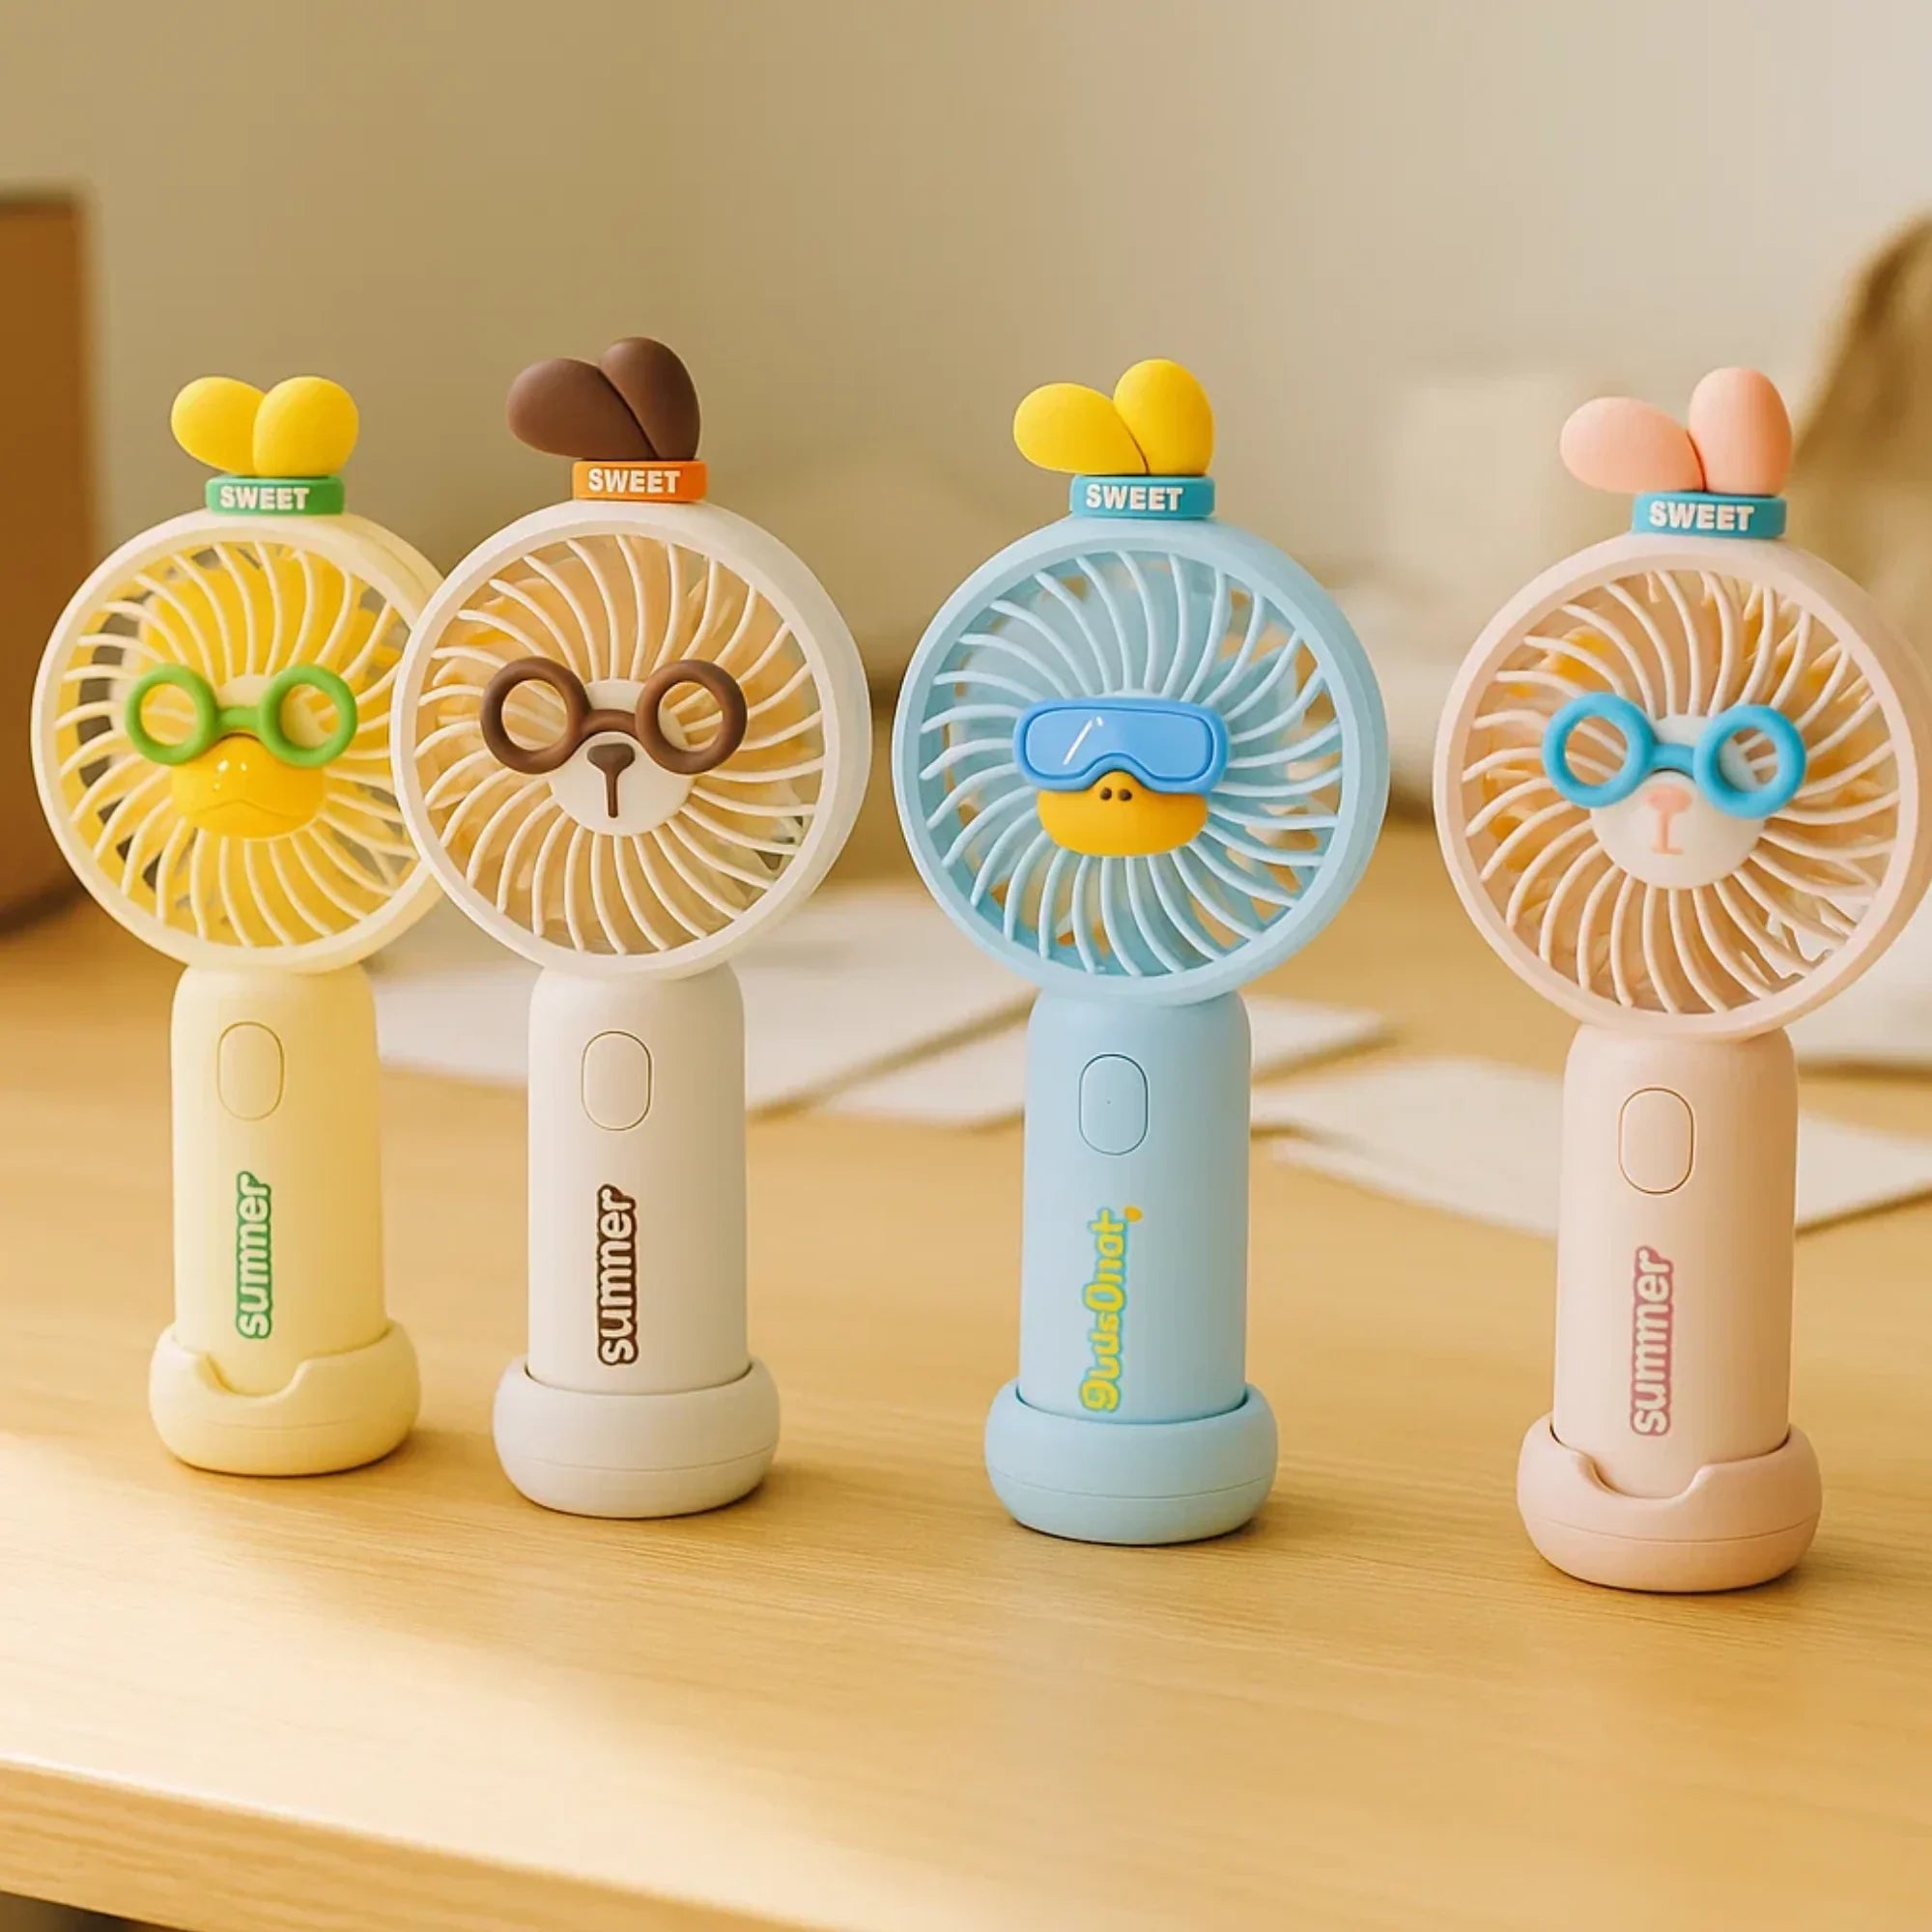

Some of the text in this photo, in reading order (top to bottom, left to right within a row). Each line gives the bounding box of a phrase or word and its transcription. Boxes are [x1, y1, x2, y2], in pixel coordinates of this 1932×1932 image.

[587, 468, 681, 494] SWEET
[220, 485, 310, 510] SWEET
[1085, 483, 1183, 511] SWEET
[1649, 500, 1754, 531] SWEET
[1631, 1246, 1673, 1435] summer
